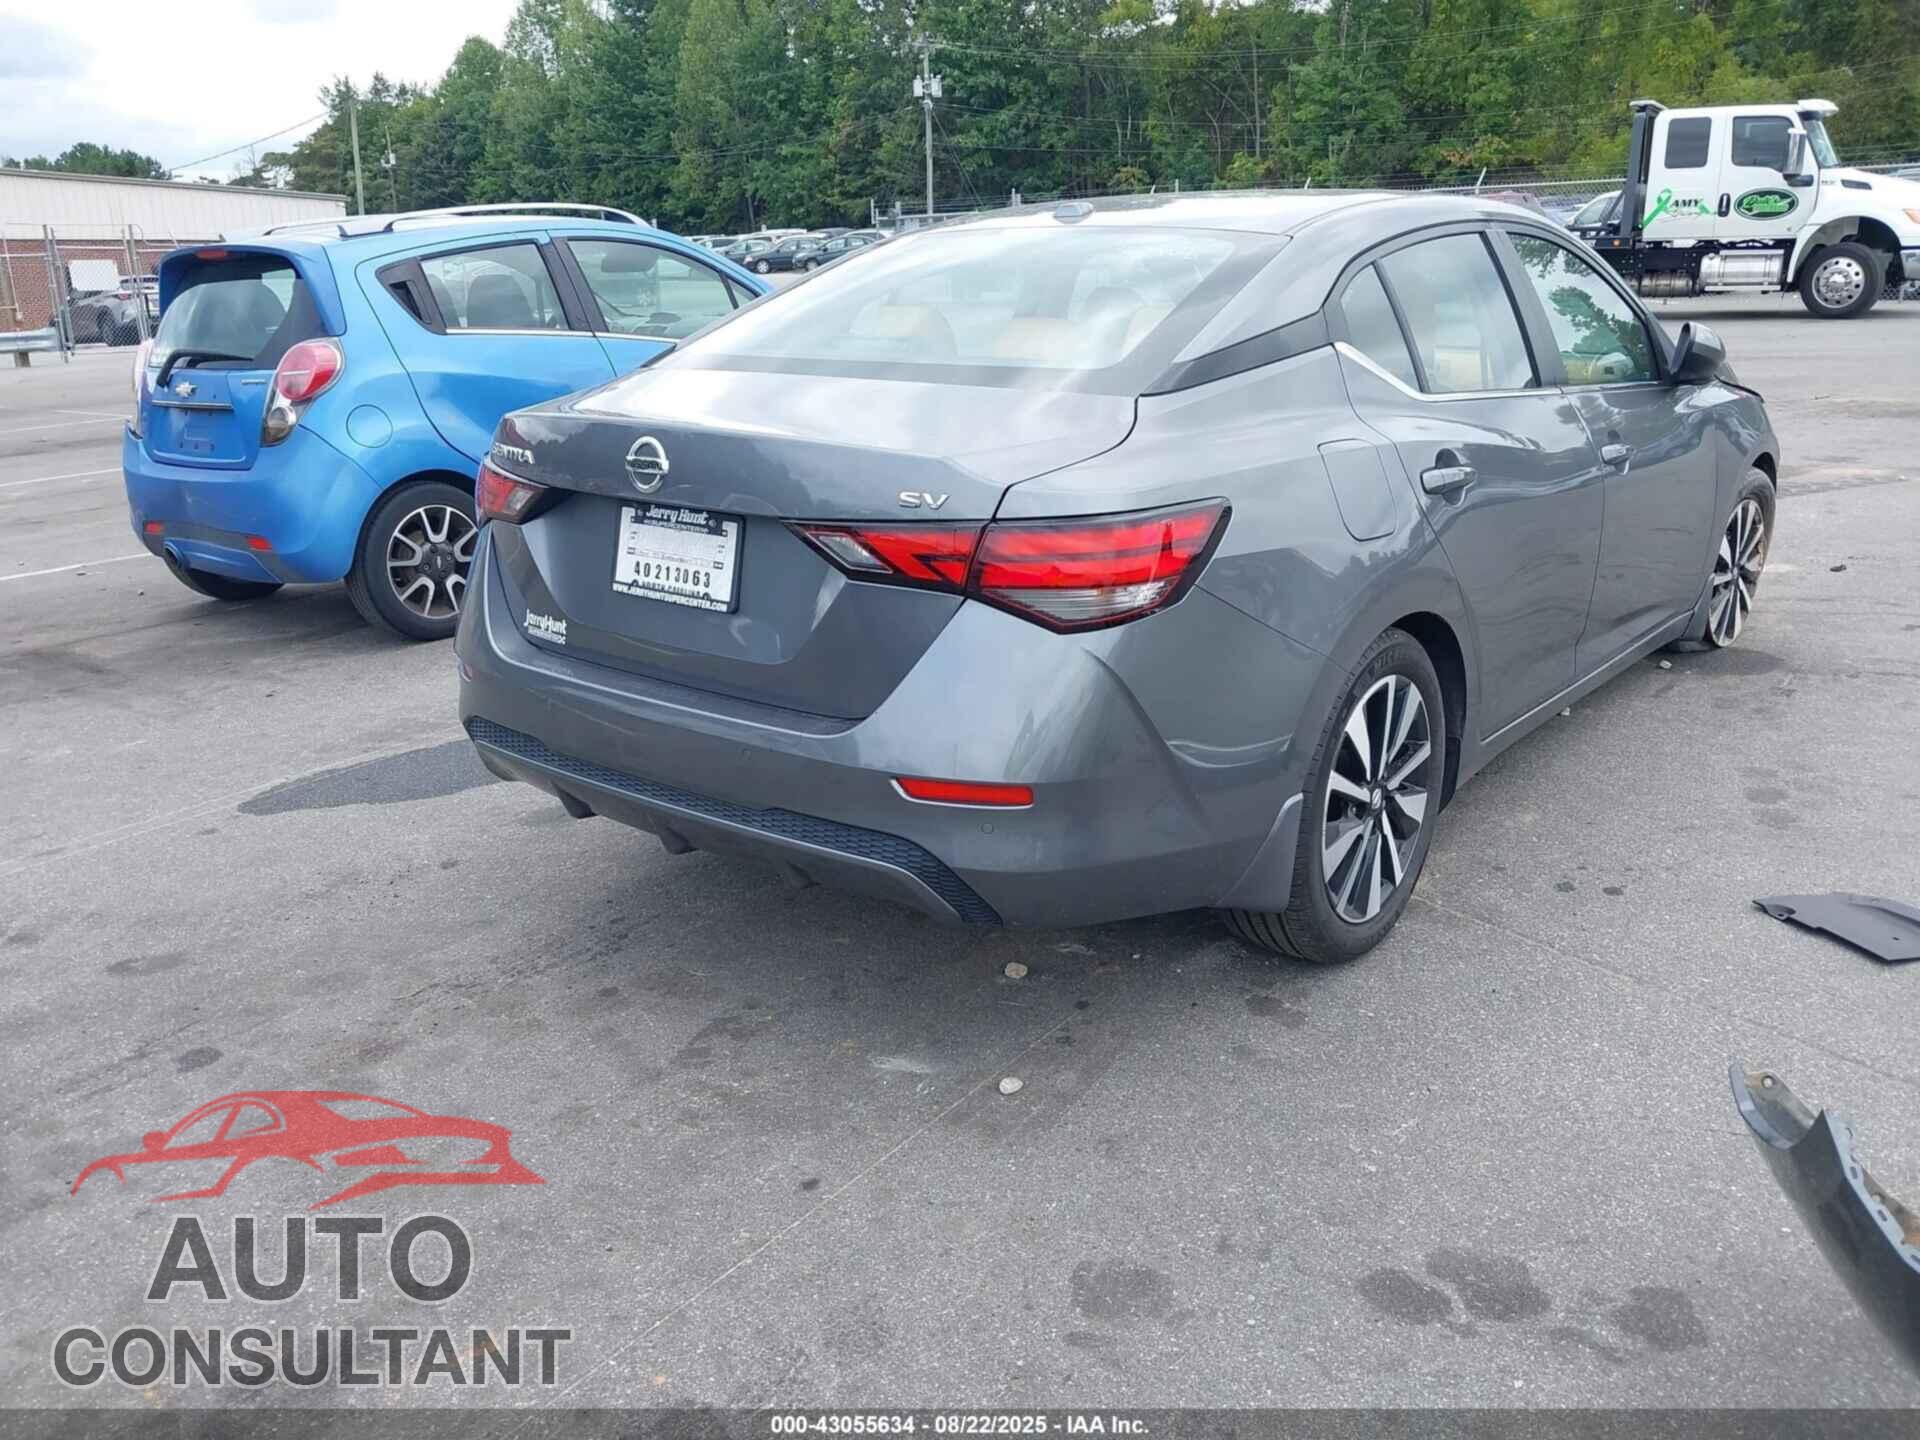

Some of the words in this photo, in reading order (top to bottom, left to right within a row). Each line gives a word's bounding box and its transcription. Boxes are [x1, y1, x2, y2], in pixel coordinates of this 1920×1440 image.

[899, 491, 950, 510] SV
[645, 504, 679, 523] Jerry
[678, 508, 709, 525] Hunt
[633, 560, 711, 588] 40213063
